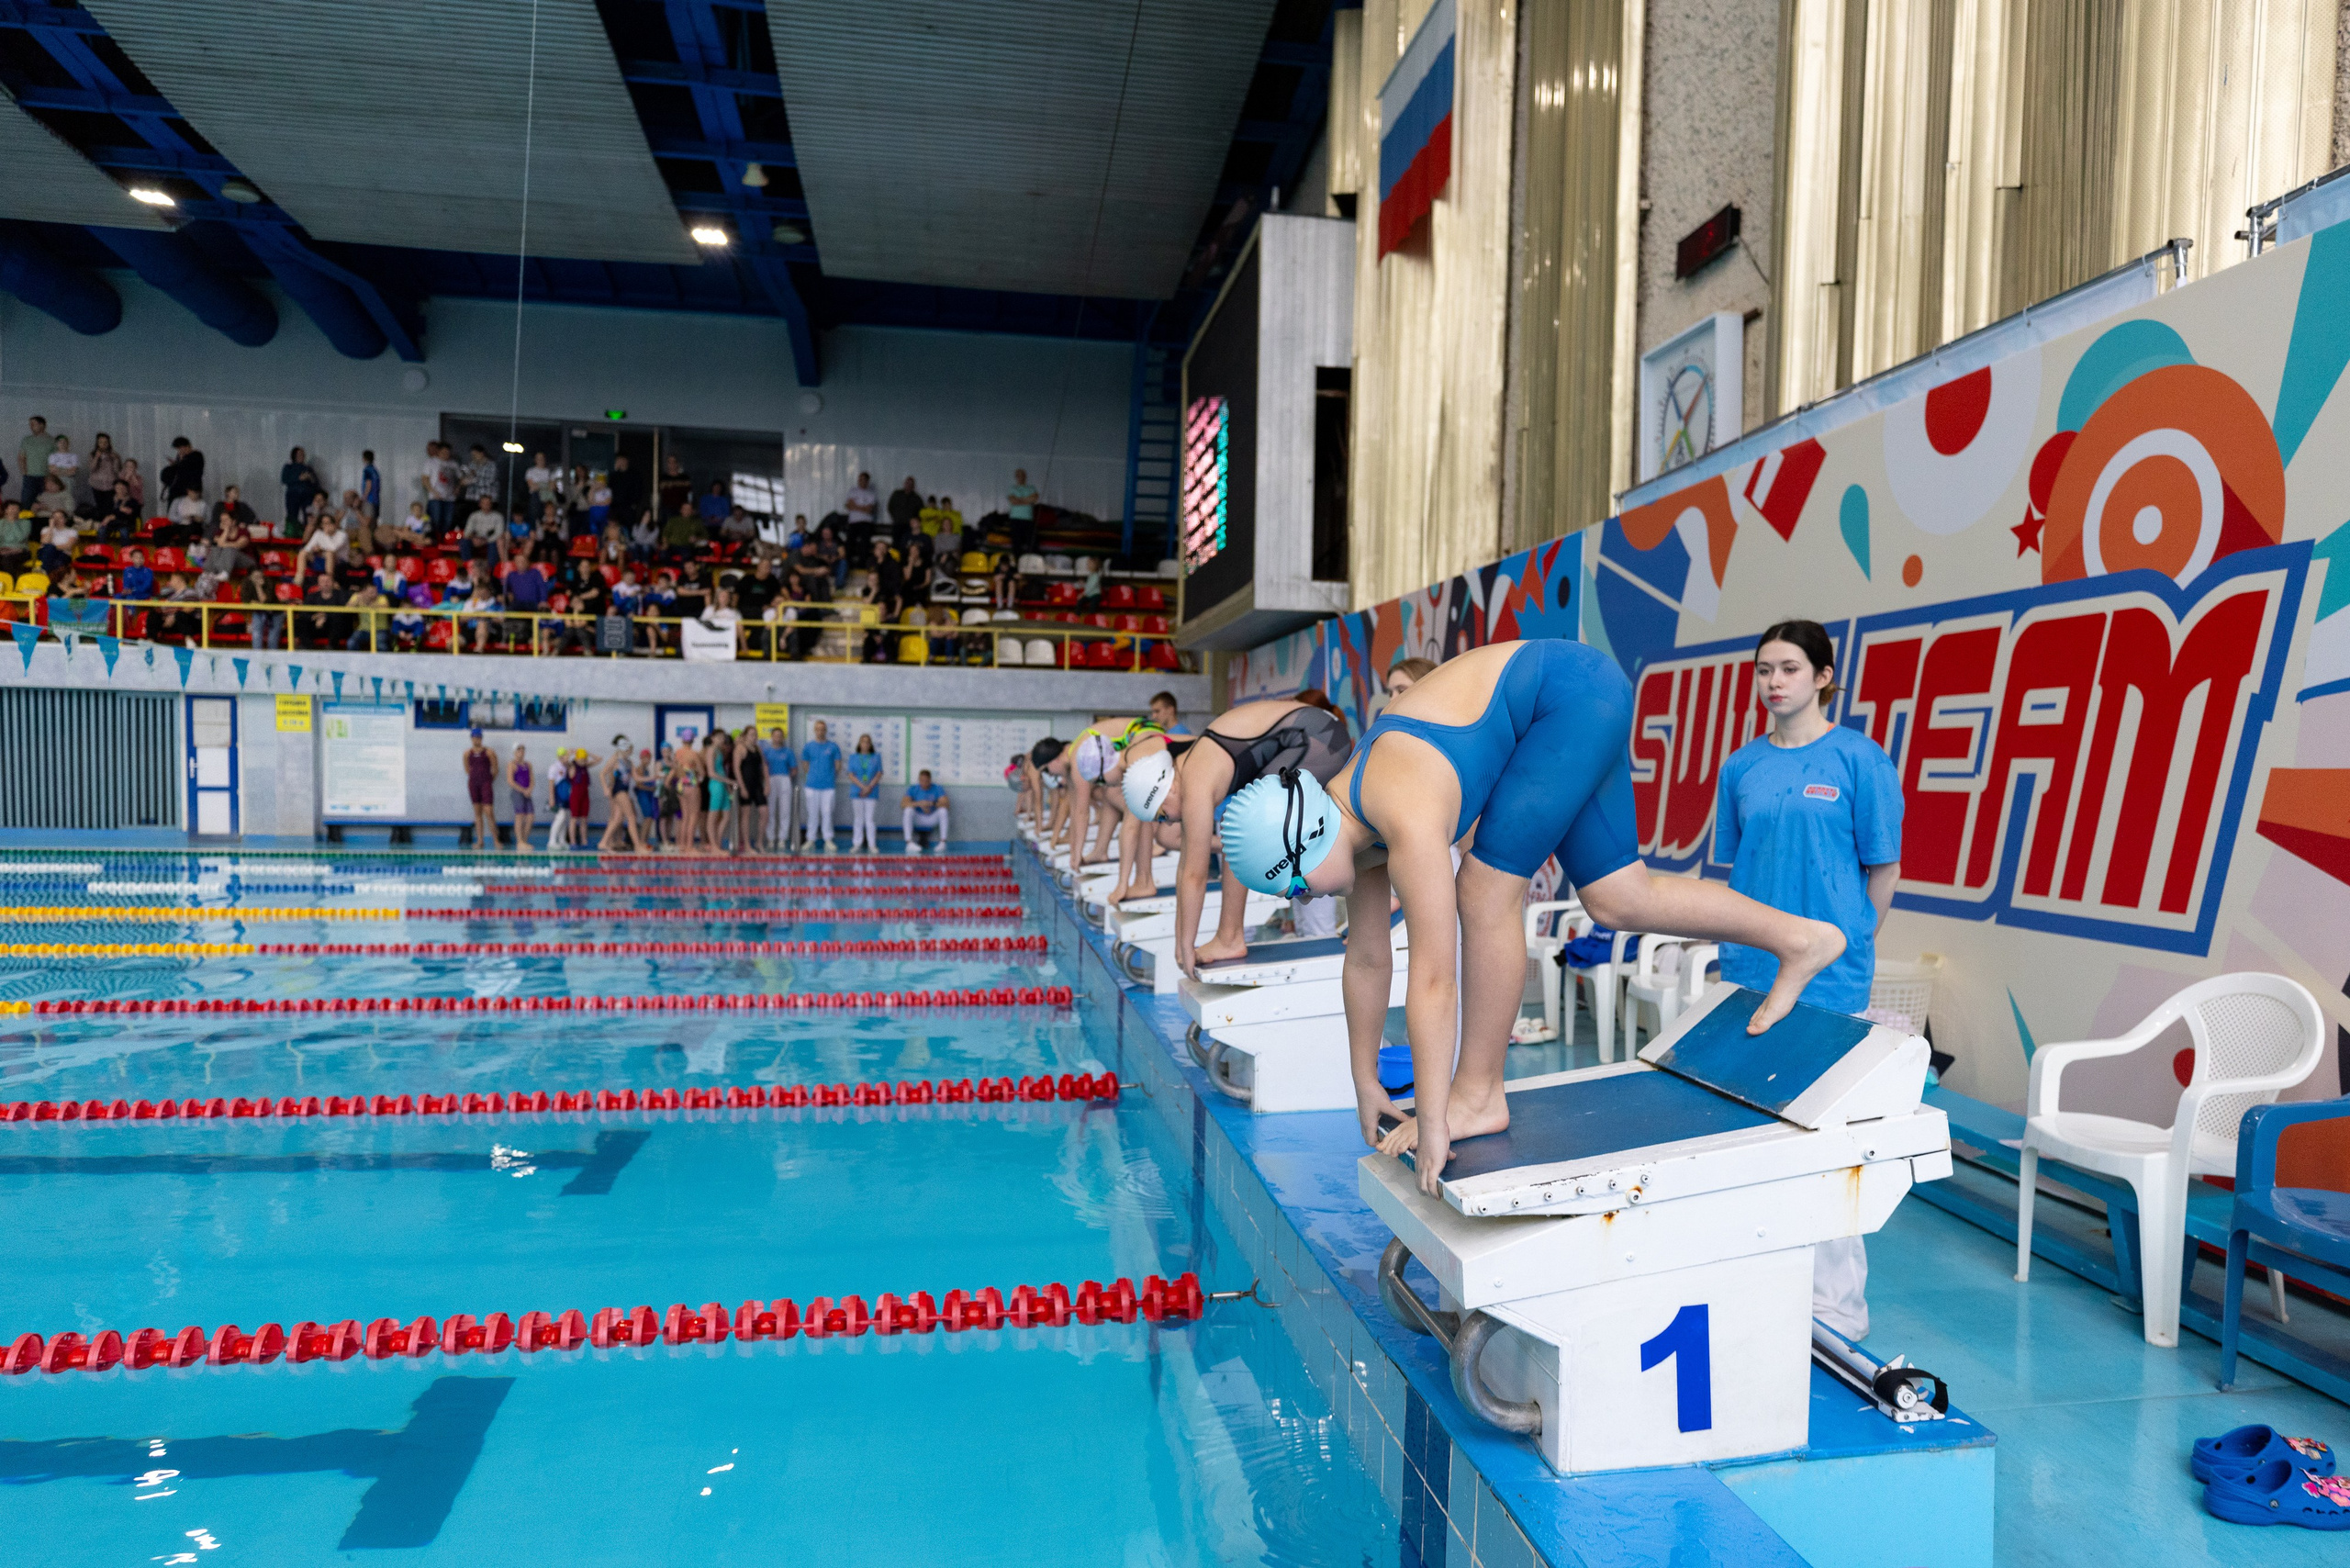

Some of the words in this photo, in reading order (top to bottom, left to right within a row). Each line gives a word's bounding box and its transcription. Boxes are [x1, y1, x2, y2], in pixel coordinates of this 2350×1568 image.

[1143, 785, 1159, 810] arena
[1632, 658, 1772, 852] SW
[1858, 588, 2270, 915] TEAM
[1639, 1303, 1712, 1434] 1
